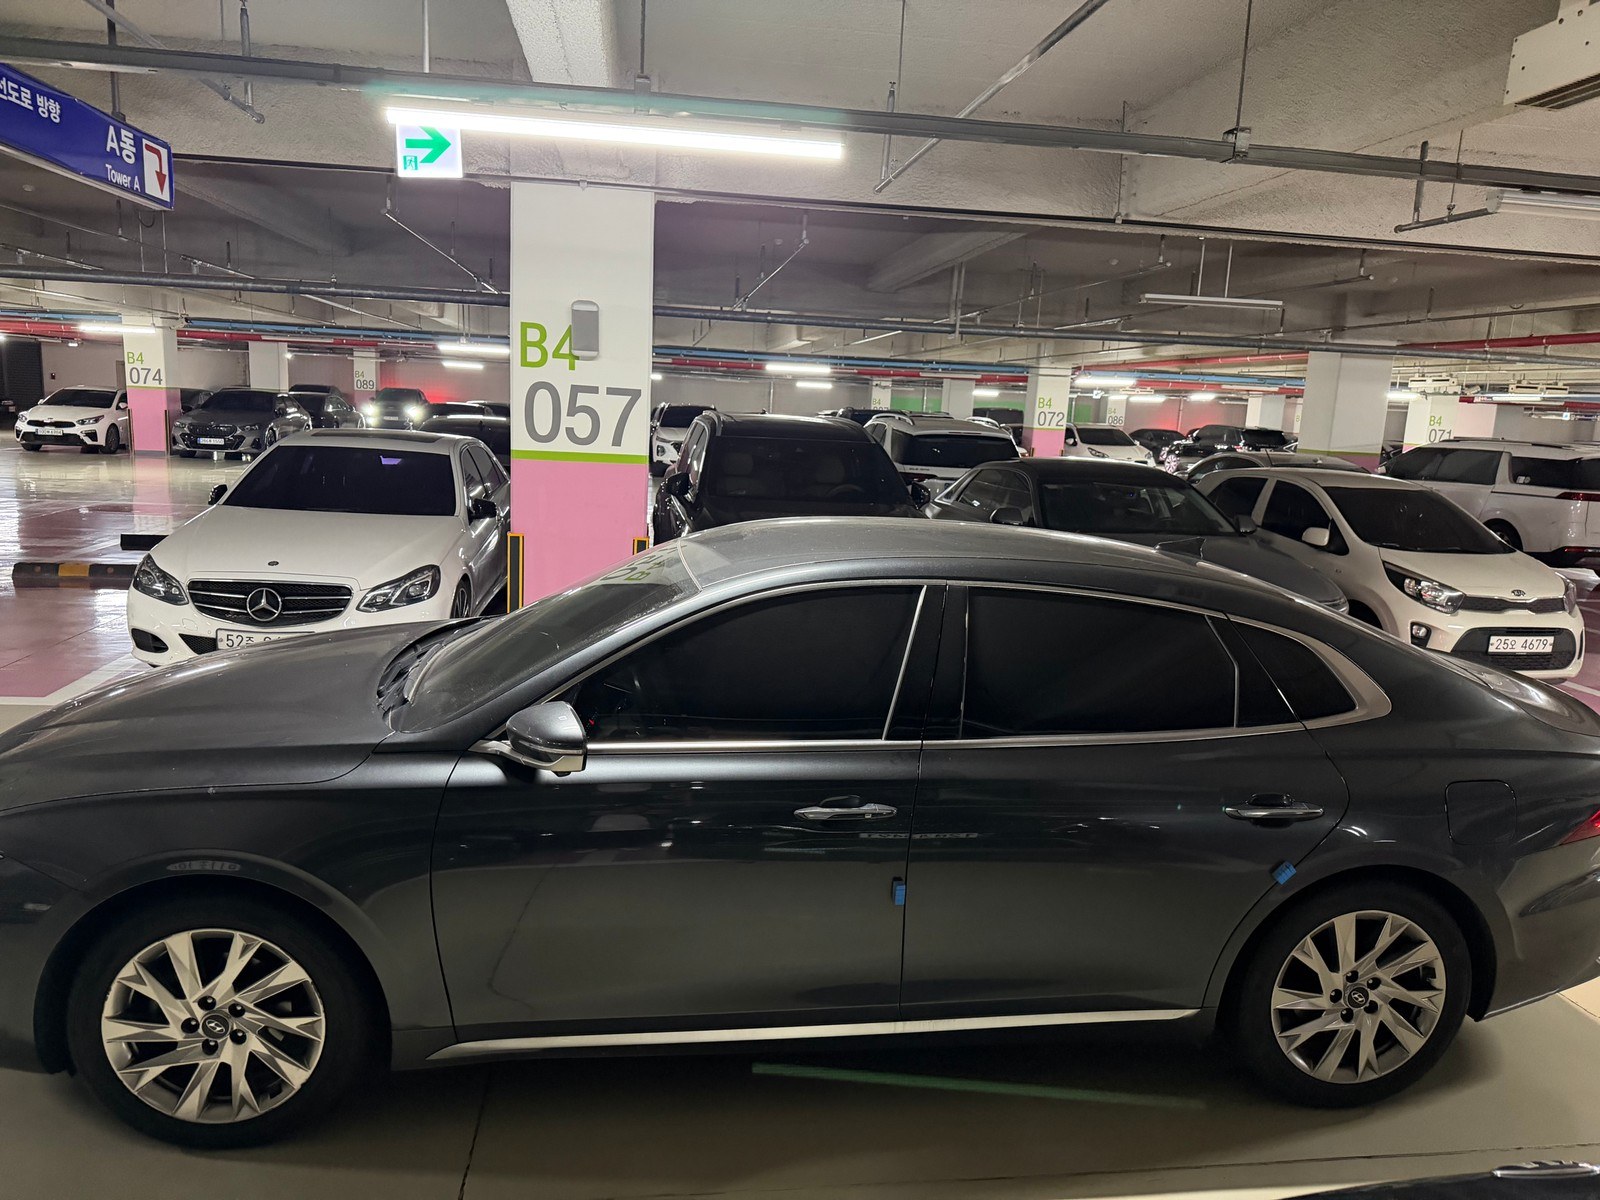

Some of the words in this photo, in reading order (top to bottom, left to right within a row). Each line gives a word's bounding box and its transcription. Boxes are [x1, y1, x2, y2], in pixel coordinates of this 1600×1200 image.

[36, 93, 61, 123] 방향
[106, 125, 136, 164] A동
[105, 163, 131, 189] Tower
[134, 175, 141, 192] A
[127, 351, 144, 365] B4
[129, 367, 163, 385] 074
[355, 370, 364, 378] B4
[356, 379, 375, 390] 089
[1038, 397, 1052, 410] B4
[524, 381, 642, 447] 057
[1037, 411, 1065, 427] 072
[1108, 415, 1124, 425] 086
[1429, 415, 1442, 426] B4
[1428, 428, 1452, 443] 071
[1495, 638, 1517, 650] 25오
[1521, 638, 1549, 651] 4679
